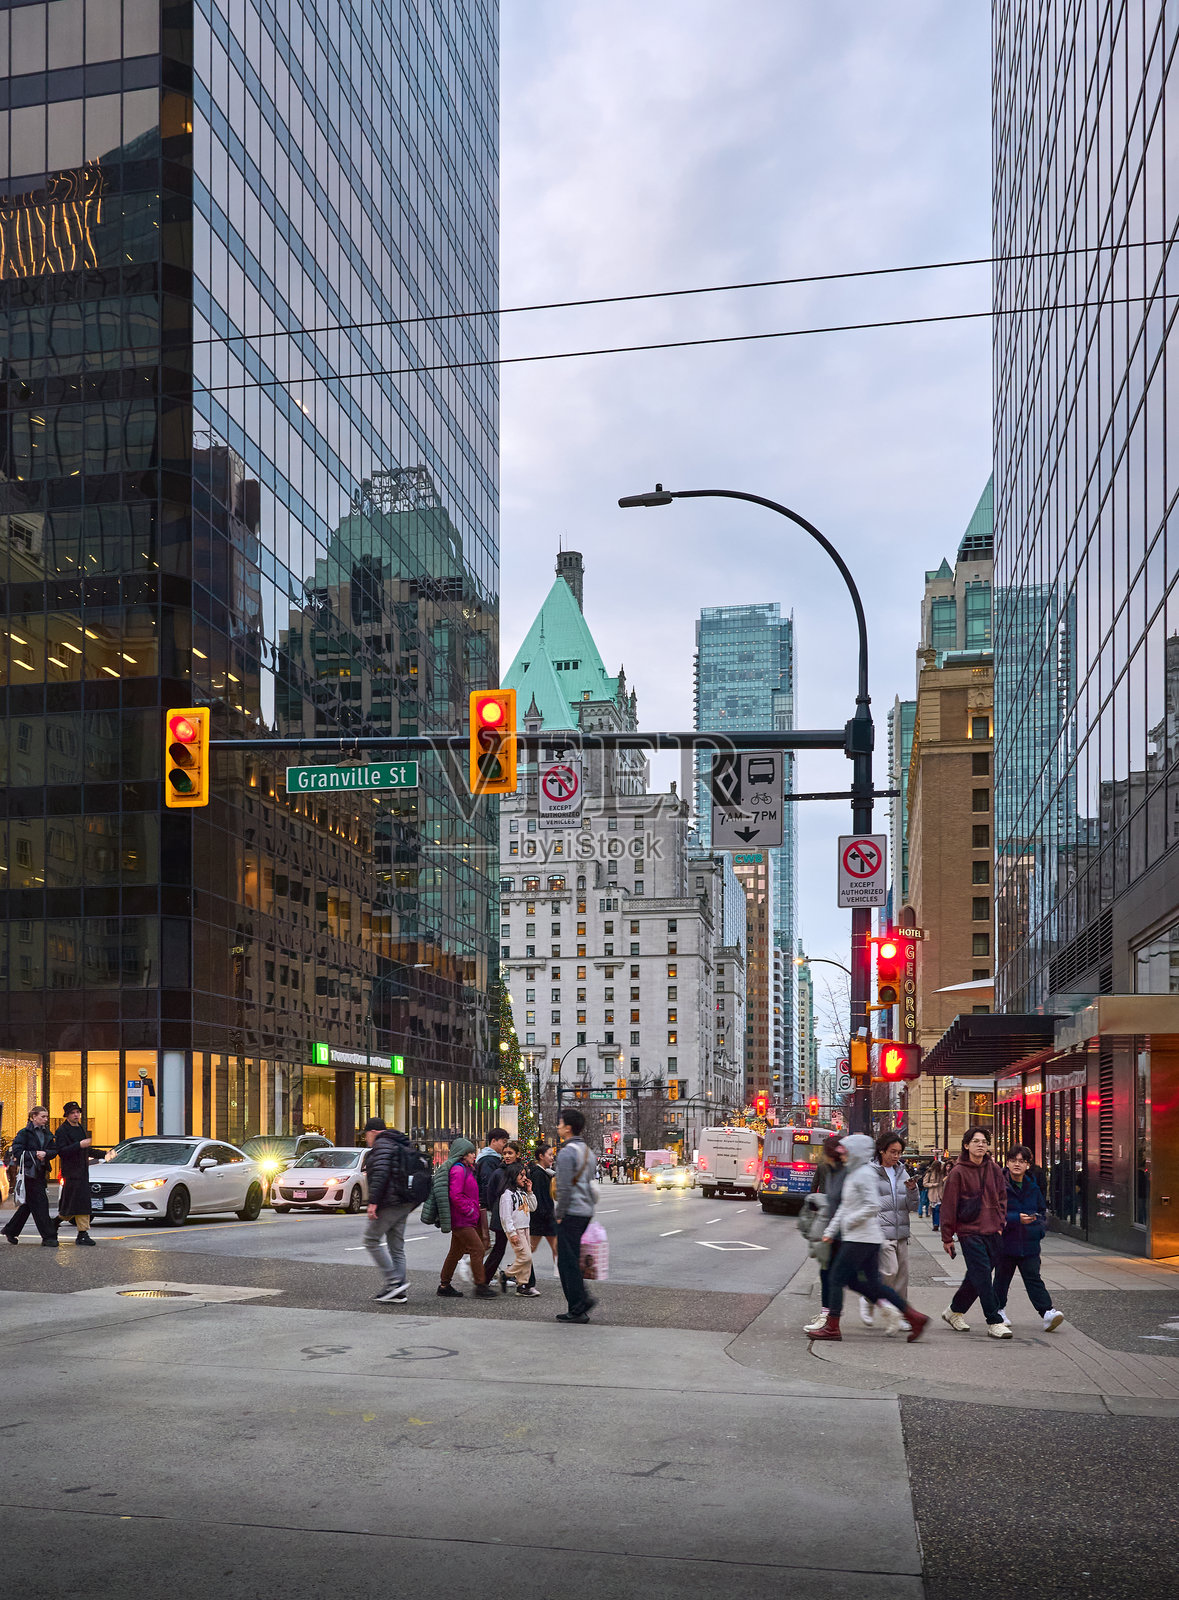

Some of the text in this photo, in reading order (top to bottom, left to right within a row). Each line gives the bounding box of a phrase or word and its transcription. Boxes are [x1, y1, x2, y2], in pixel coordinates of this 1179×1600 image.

[298, 766, 407, 789] Granville St
[734, 854, 763, 864] CWB
[898, 928, 922, 938] HOTEL
[904, 944, 915, 1044] GEORGI
[794, 1134, 809, 1142] 240
